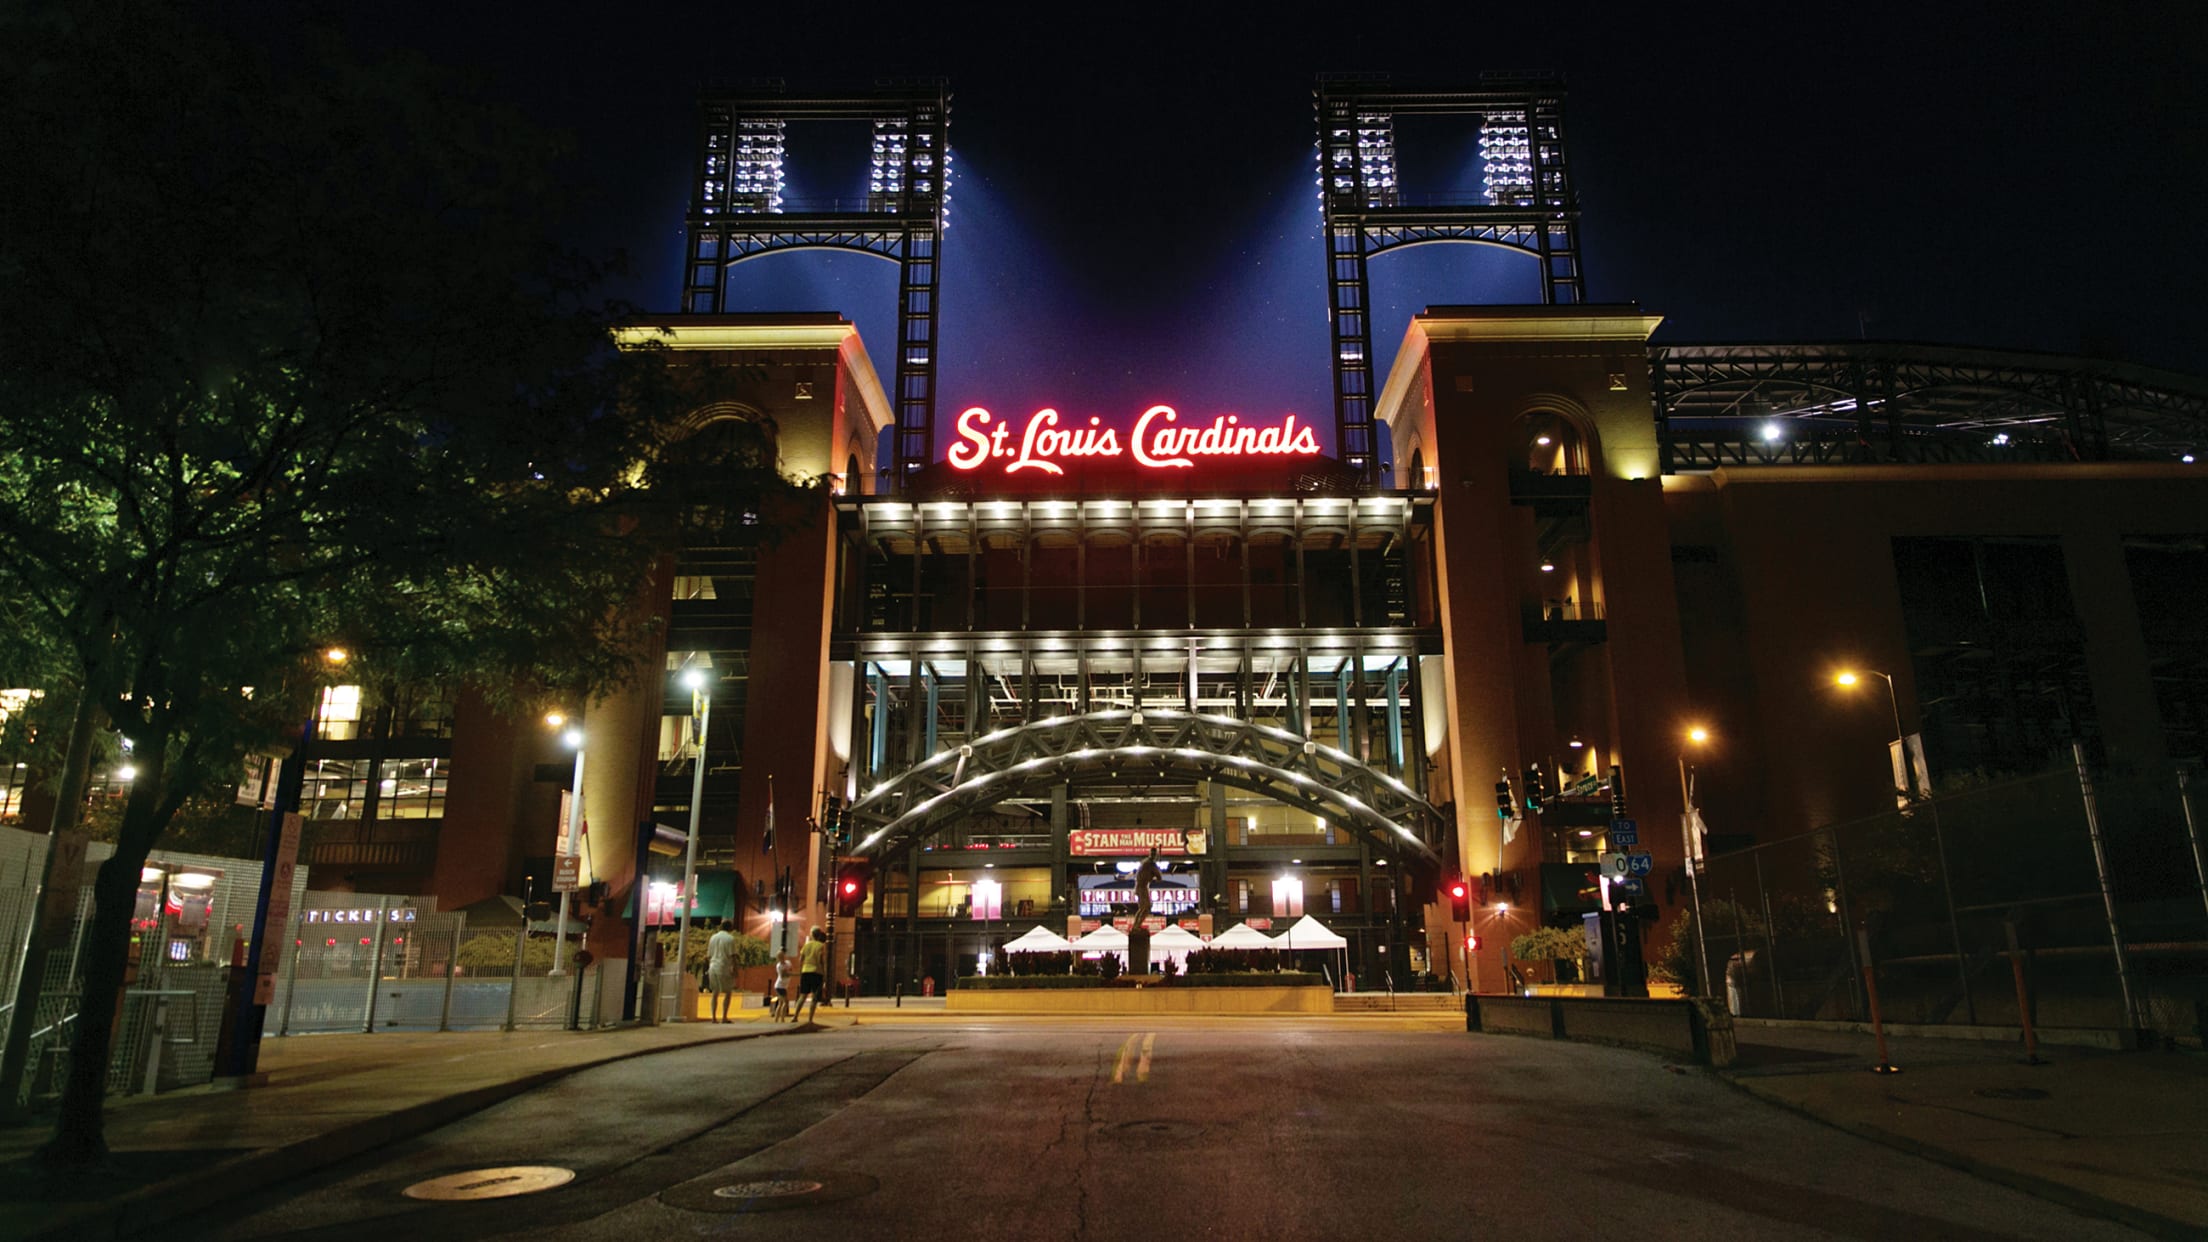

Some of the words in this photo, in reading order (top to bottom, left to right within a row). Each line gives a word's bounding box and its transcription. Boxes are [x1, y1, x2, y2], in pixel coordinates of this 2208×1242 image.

[948, 406, 1016, 470] St.
[1005, 408, 1123, 475] Louis
[1131, 404, 1321, 468] Cardinals
[1618, 821, 1631, 830] TO
[1084, 832, 1119, 847] STAN
[1133, 832, 1185, 847] MUSIAL
[1616, 834, 1636, 844] EAST
[1631, 857, 1650, 871] 64
[1150, 890, 1199, 902] BASE
[308, 909, 400, 922] TICKES
